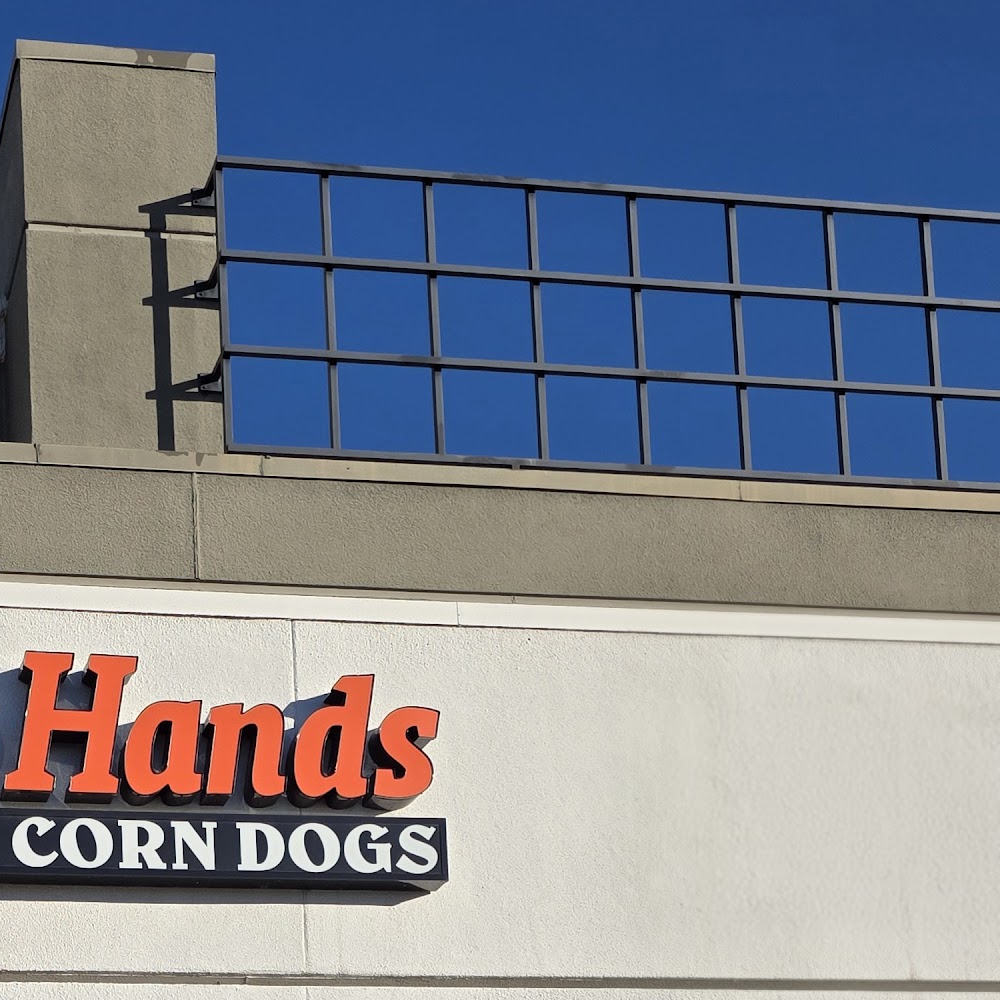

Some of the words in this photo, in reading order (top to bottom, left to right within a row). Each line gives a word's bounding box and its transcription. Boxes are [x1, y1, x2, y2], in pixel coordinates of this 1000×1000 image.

[3, 650, 441, 802] Hands
[11, 816, 218, 871] CORN
[236, 821, 440, 875] DOGS
